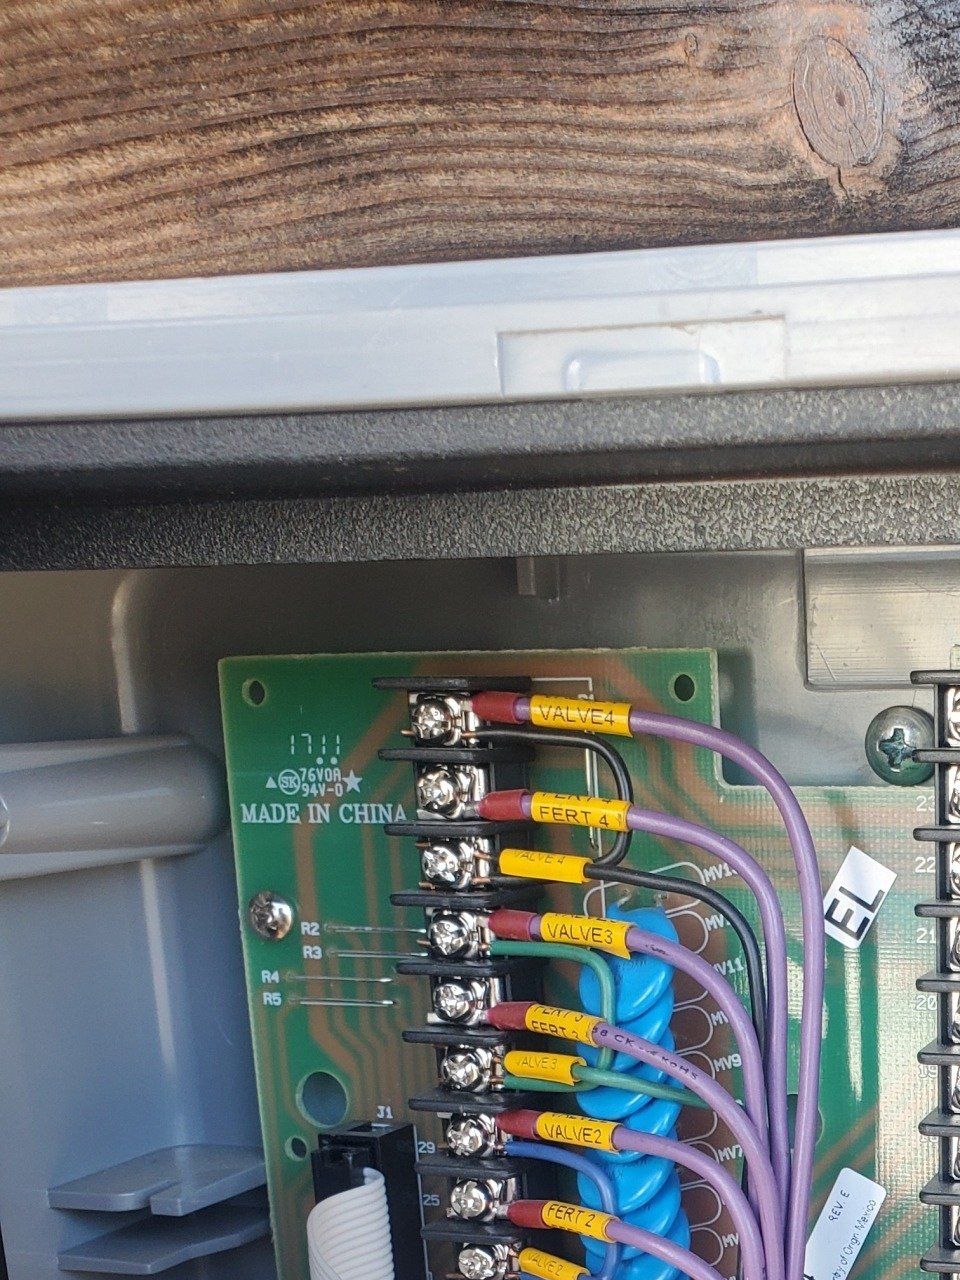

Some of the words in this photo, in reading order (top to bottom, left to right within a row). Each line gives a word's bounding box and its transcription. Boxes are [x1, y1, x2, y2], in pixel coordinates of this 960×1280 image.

[538, 704, 615, 726] VALVE4
[241, 803, 301, 824] MADE
[307, 803, 330, 824] IN
[339, 803, 407, 824] CHINA
[540, 806, 592, 825] FERT
[599, 814, 609, 828] 4
[703, 862, 738, 883] MV1
[915, 857, 936, 873] 22
[824, 886, 886, 942] EL
[301, 922, 320, 936] R2
[547, 923, 613, 945] VALVE3
[916, 928, 937, 944] 21
[303, 945, 322, 959] R3
[261, 970, 280, 984] R4
[263, 992, 282, 1006] R5
[713, 1054, 742, 1072] MV9
[376, 1106, 394, 1119] J1
[545, 1124, 602, 1145] VALVE2
[548, 1203, 586, 1225] FERT
[586, 1214, 596, 1228] 2
